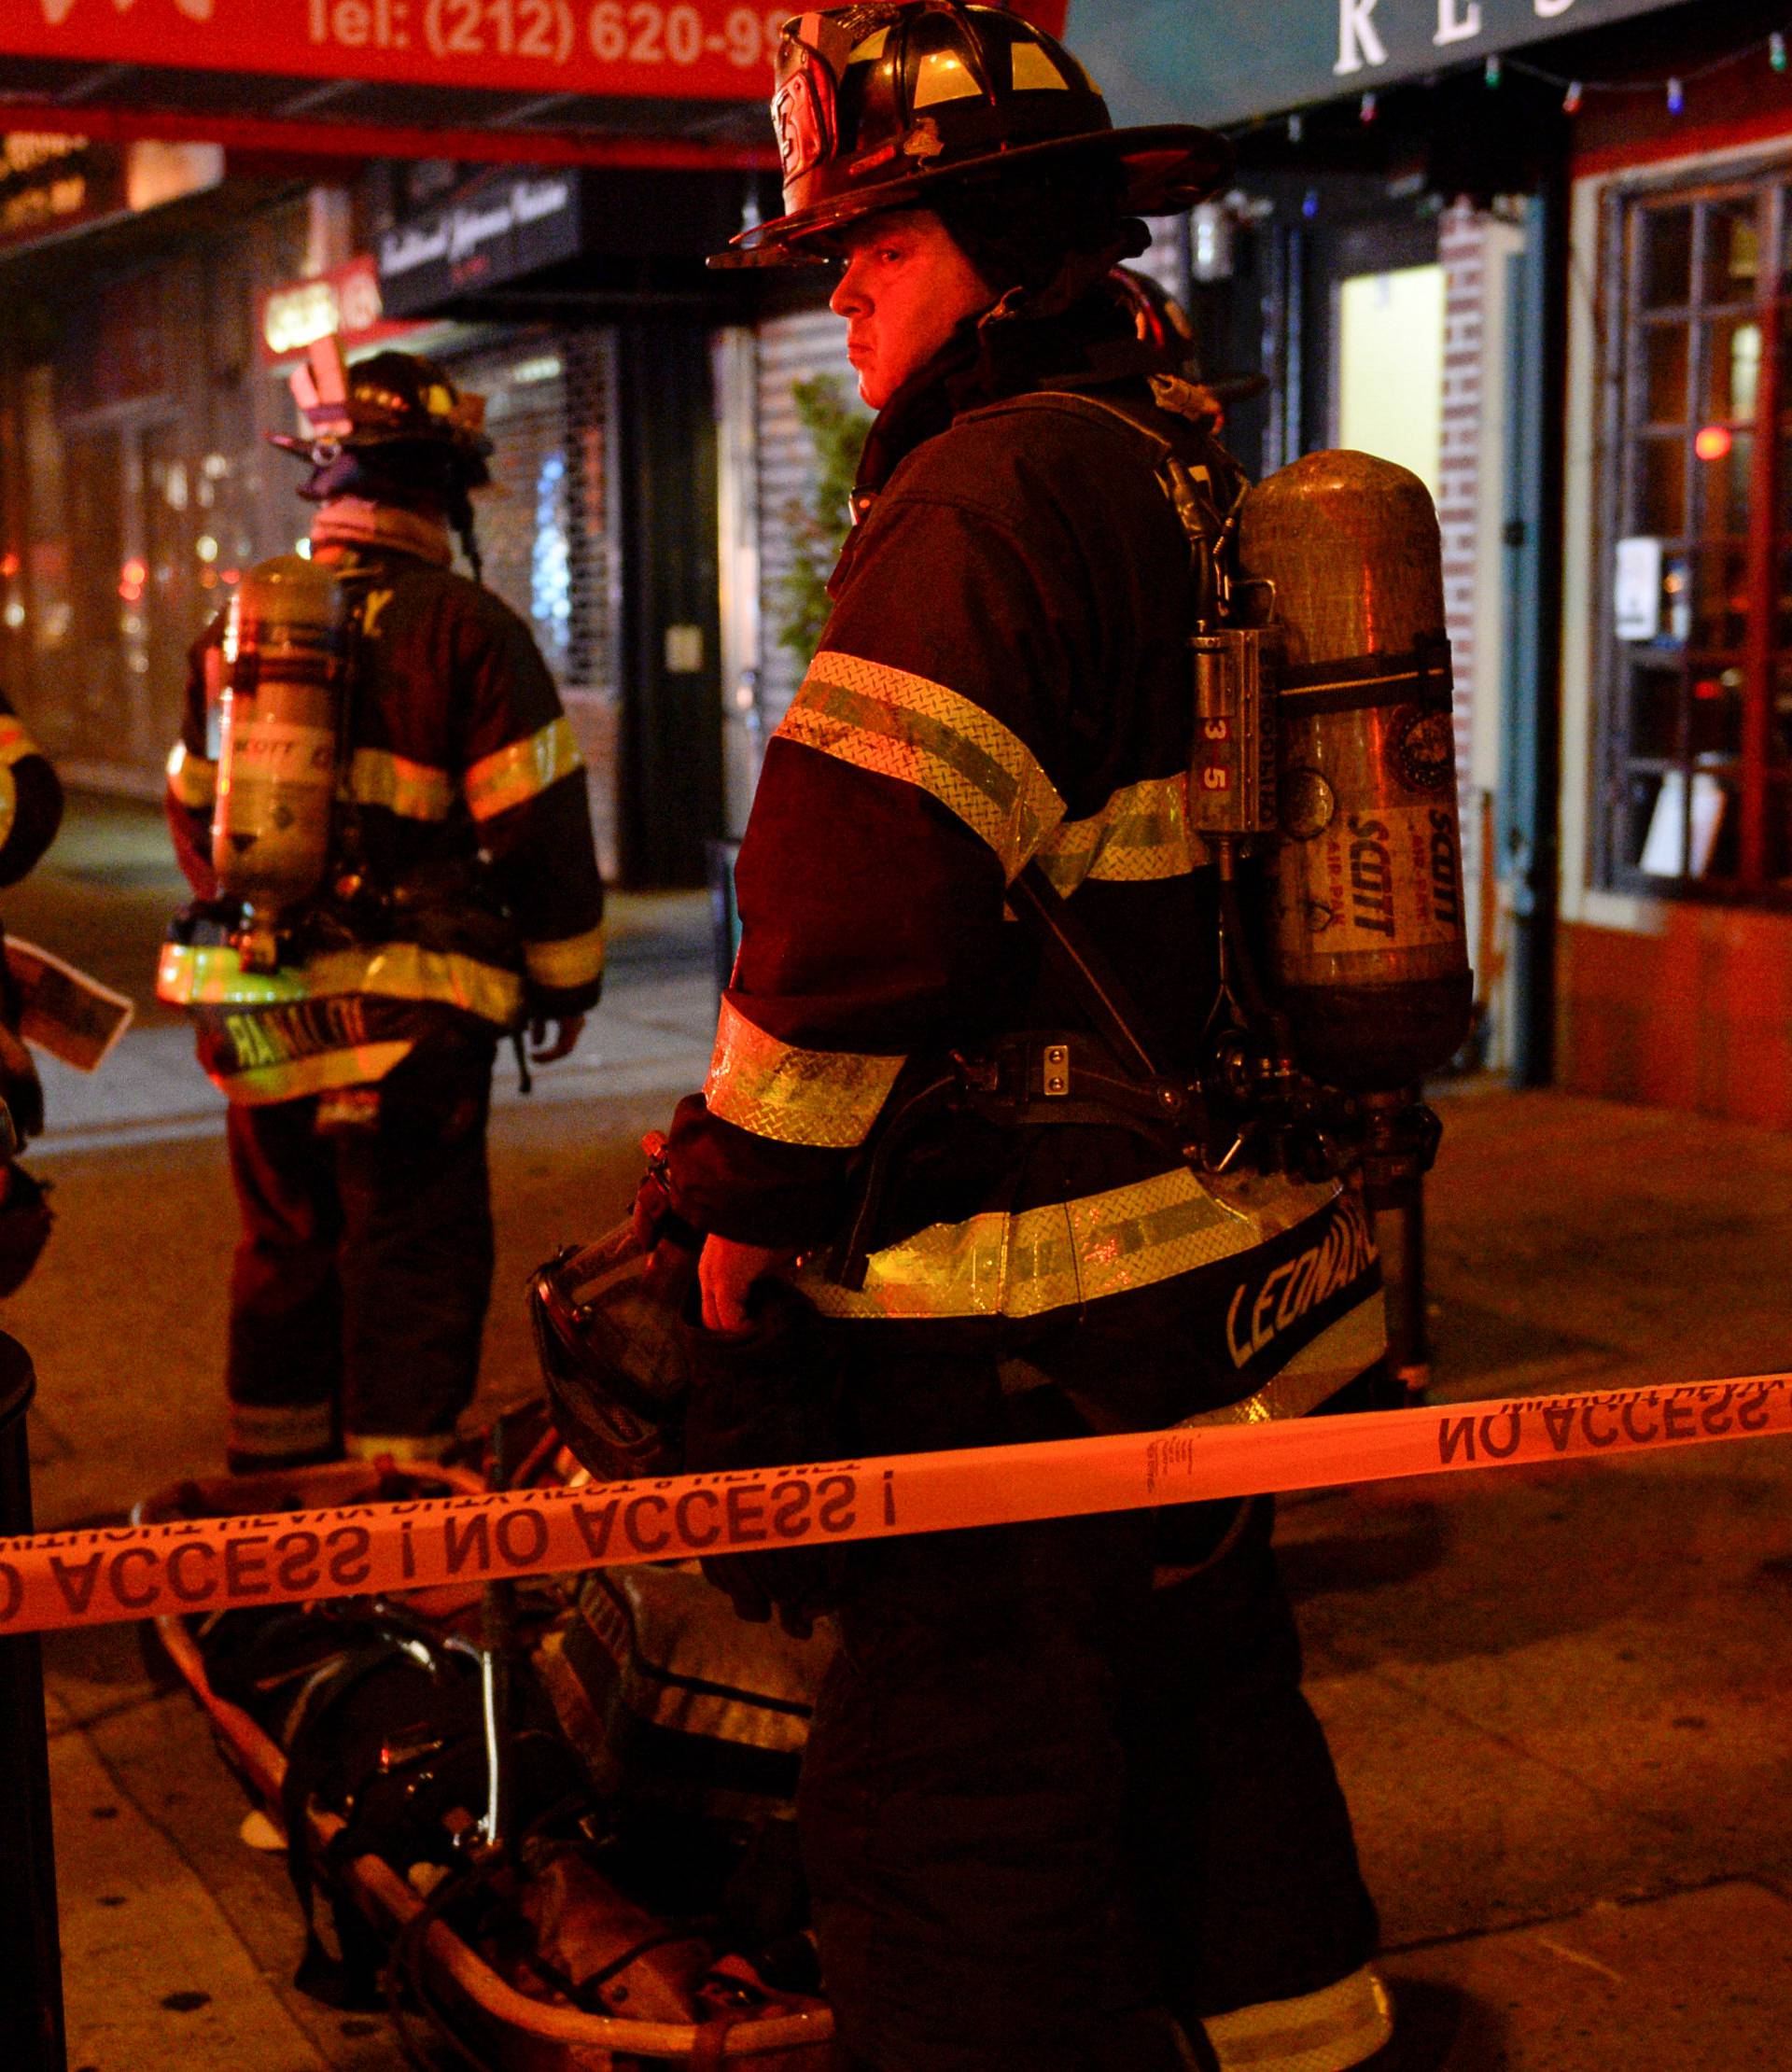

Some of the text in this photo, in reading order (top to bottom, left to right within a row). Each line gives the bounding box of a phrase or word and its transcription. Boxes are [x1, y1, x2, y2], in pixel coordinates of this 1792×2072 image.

[425, 0, 575, 63] (212)
[1204, 720, 1226, 790] 3 5
[1347, 814, 1395, 938] SCOTT
